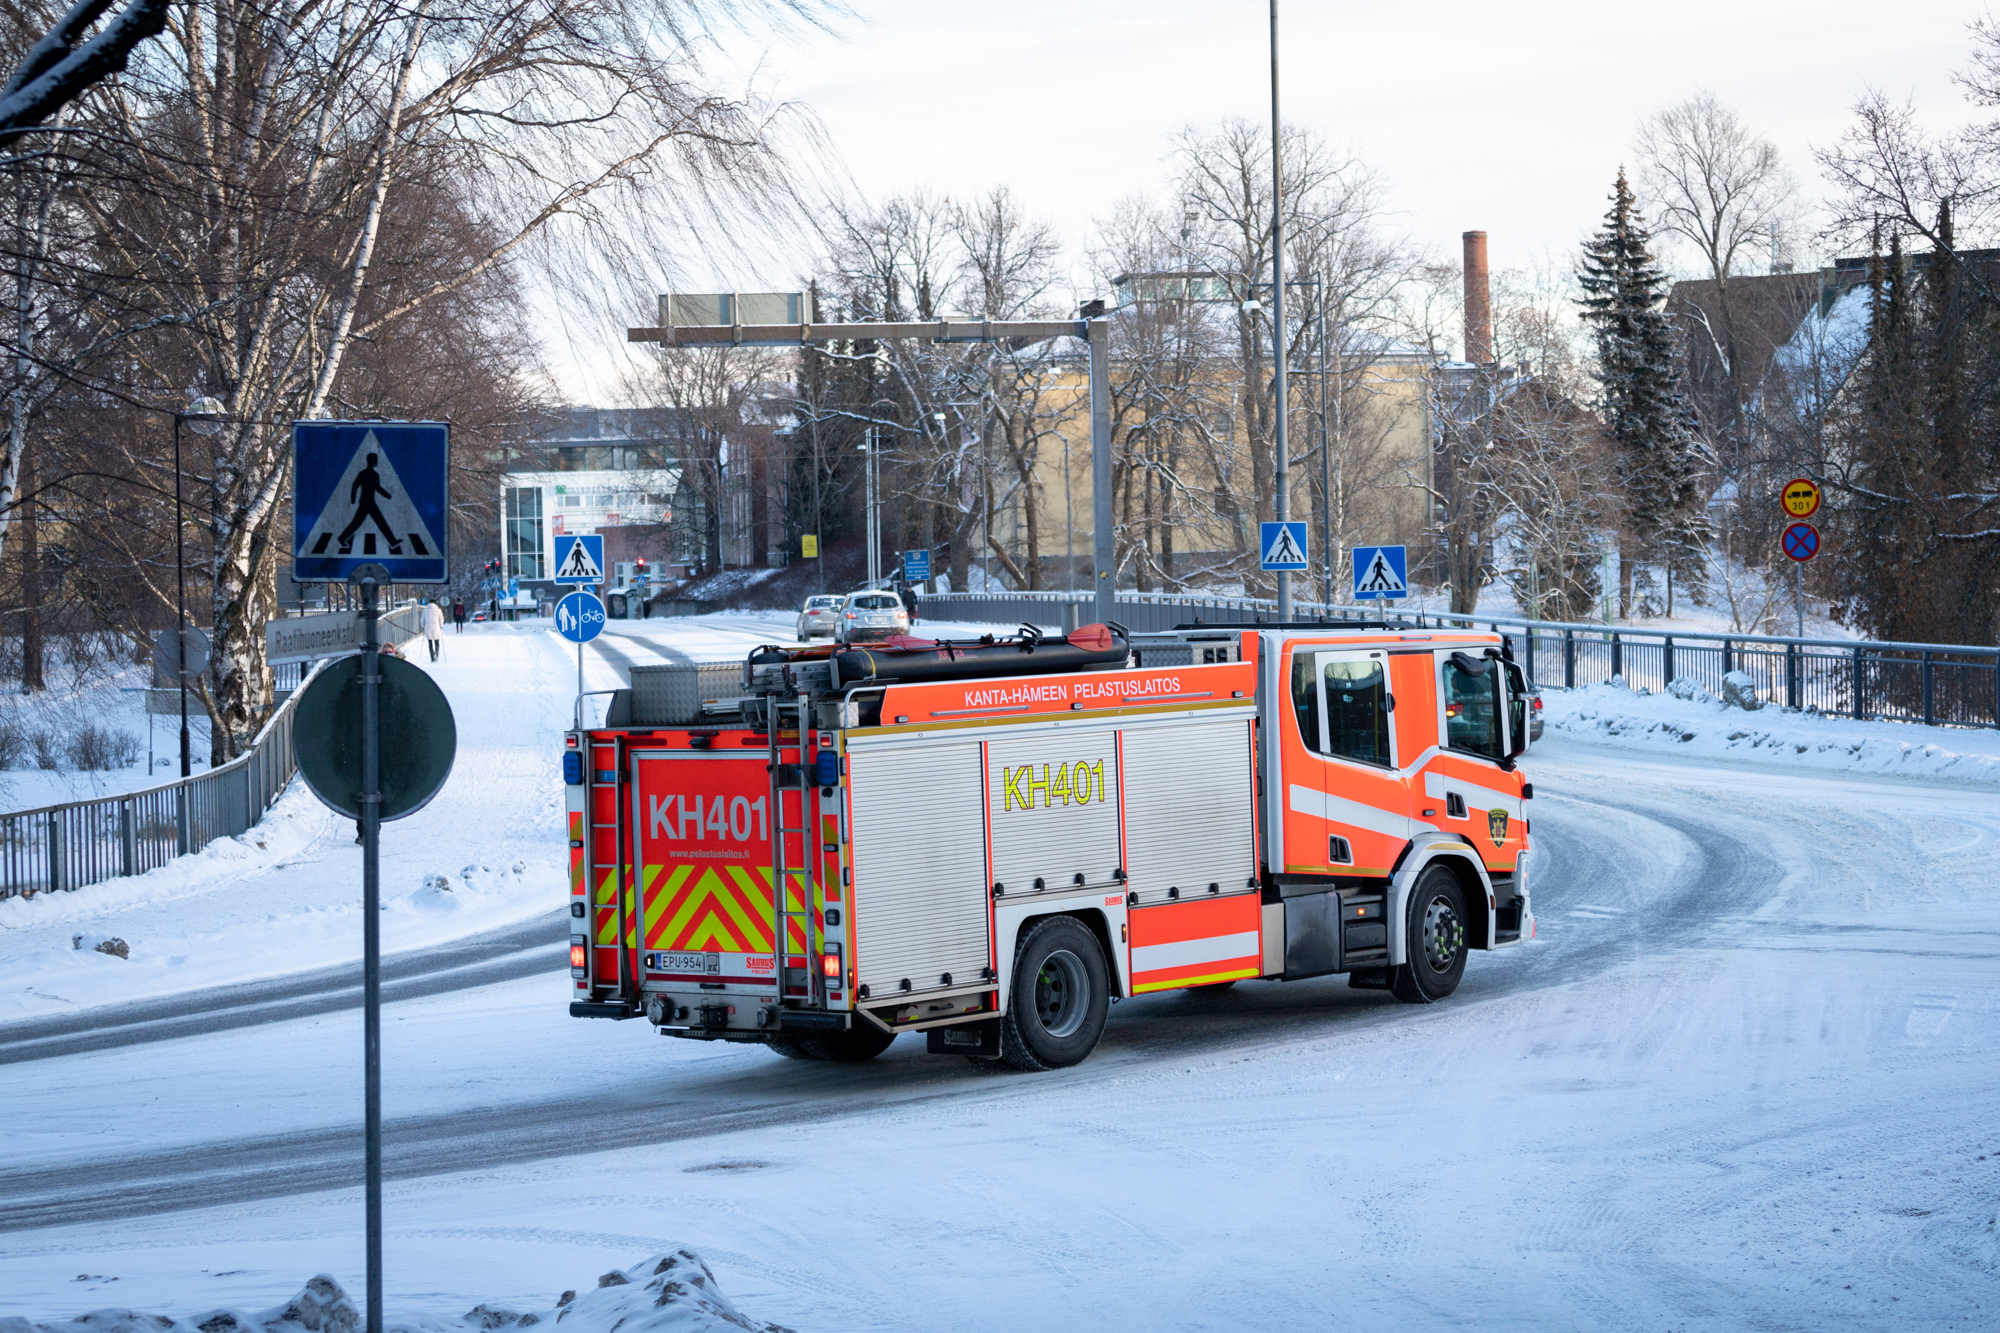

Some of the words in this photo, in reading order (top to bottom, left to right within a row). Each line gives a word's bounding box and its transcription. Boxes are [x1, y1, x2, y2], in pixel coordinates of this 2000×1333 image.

[1792, 501, 1803, 510] 30
[275, 622, 355, 654] Raatihuoneenkatu
[937, 649, 965, 659] RECA
[964, 684, 1068, 707] KANTA-HÄMEEN
[1074, 677, 1181, 699] PELASTUSLAITOS
[1003, 758, 1105, 811] KH401
[649, 794, 768, 842] KH401
[669, 849, 750, 859] www.pelastuslaitos.fi
[662, 956, 702, 969] EPU-954
[746, 956, 775, 970] SAURUS
